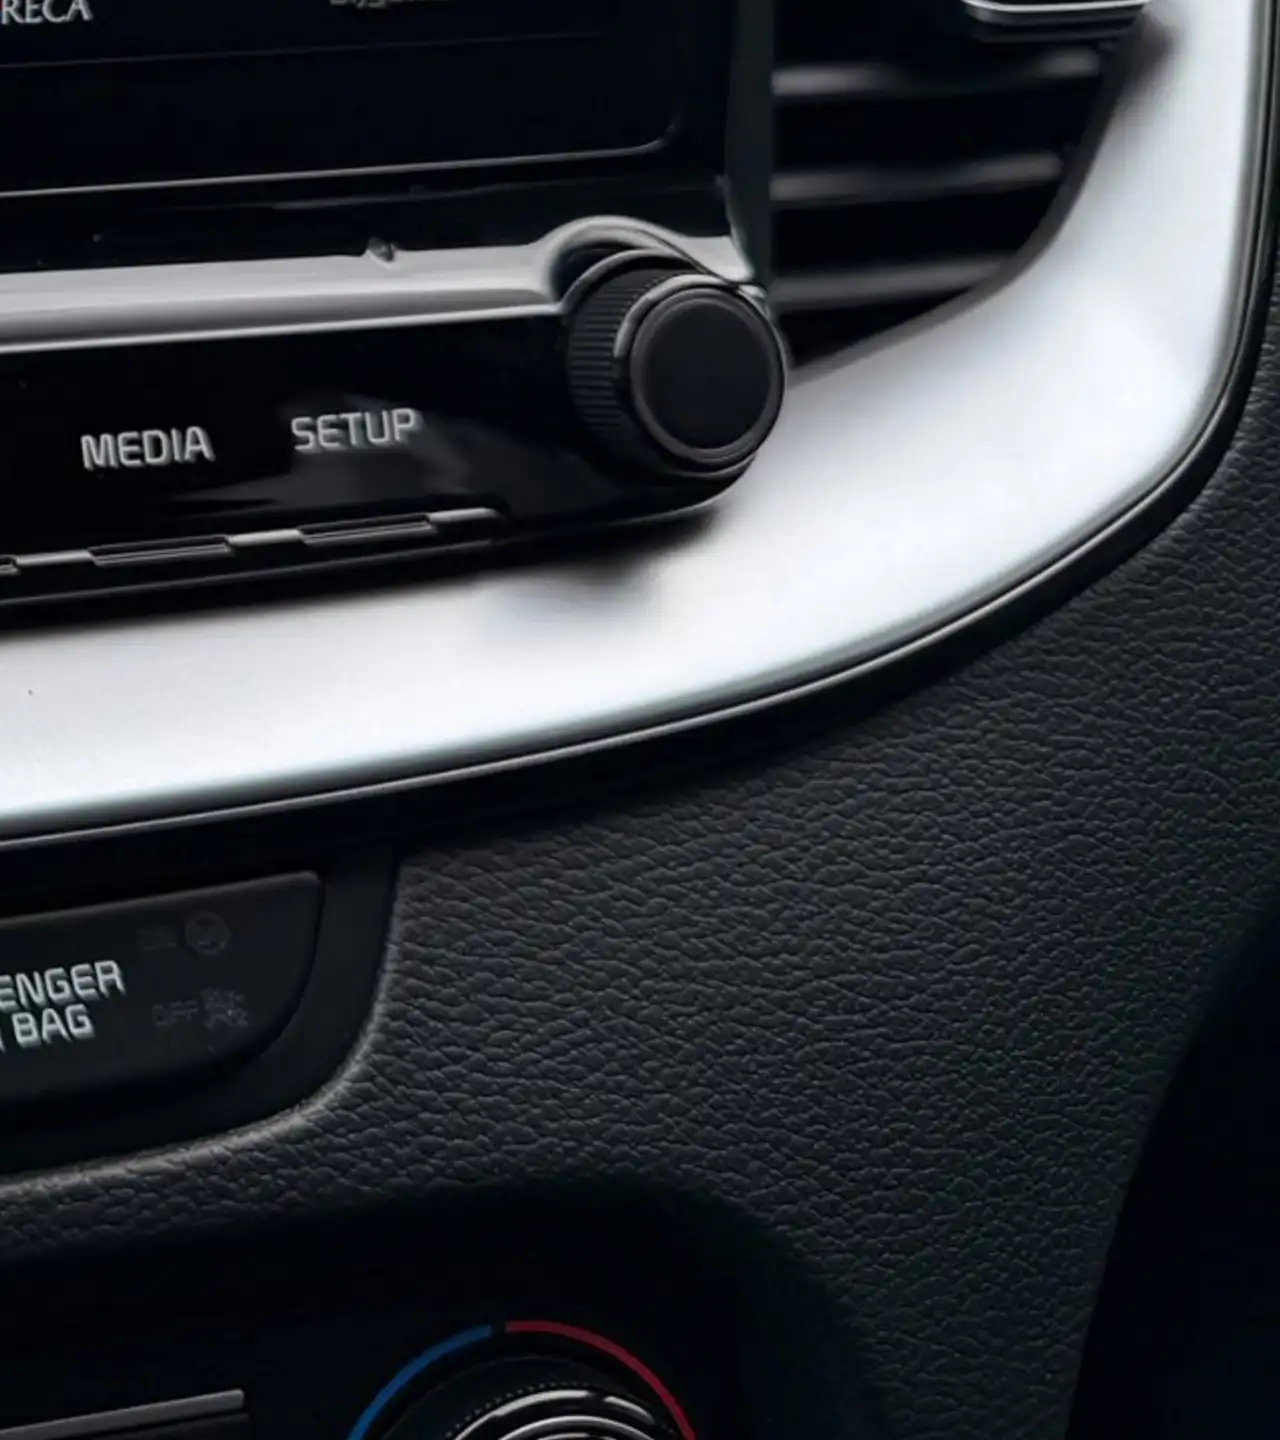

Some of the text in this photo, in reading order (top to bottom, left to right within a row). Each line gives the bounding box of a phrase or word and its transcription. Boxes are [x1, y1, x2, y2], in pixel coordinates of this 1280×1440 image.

[78, 425, 215, 472] MEDIA
[290, 406, 422, 453] SETUP
[13, 1002, 96, 1050] BAG
